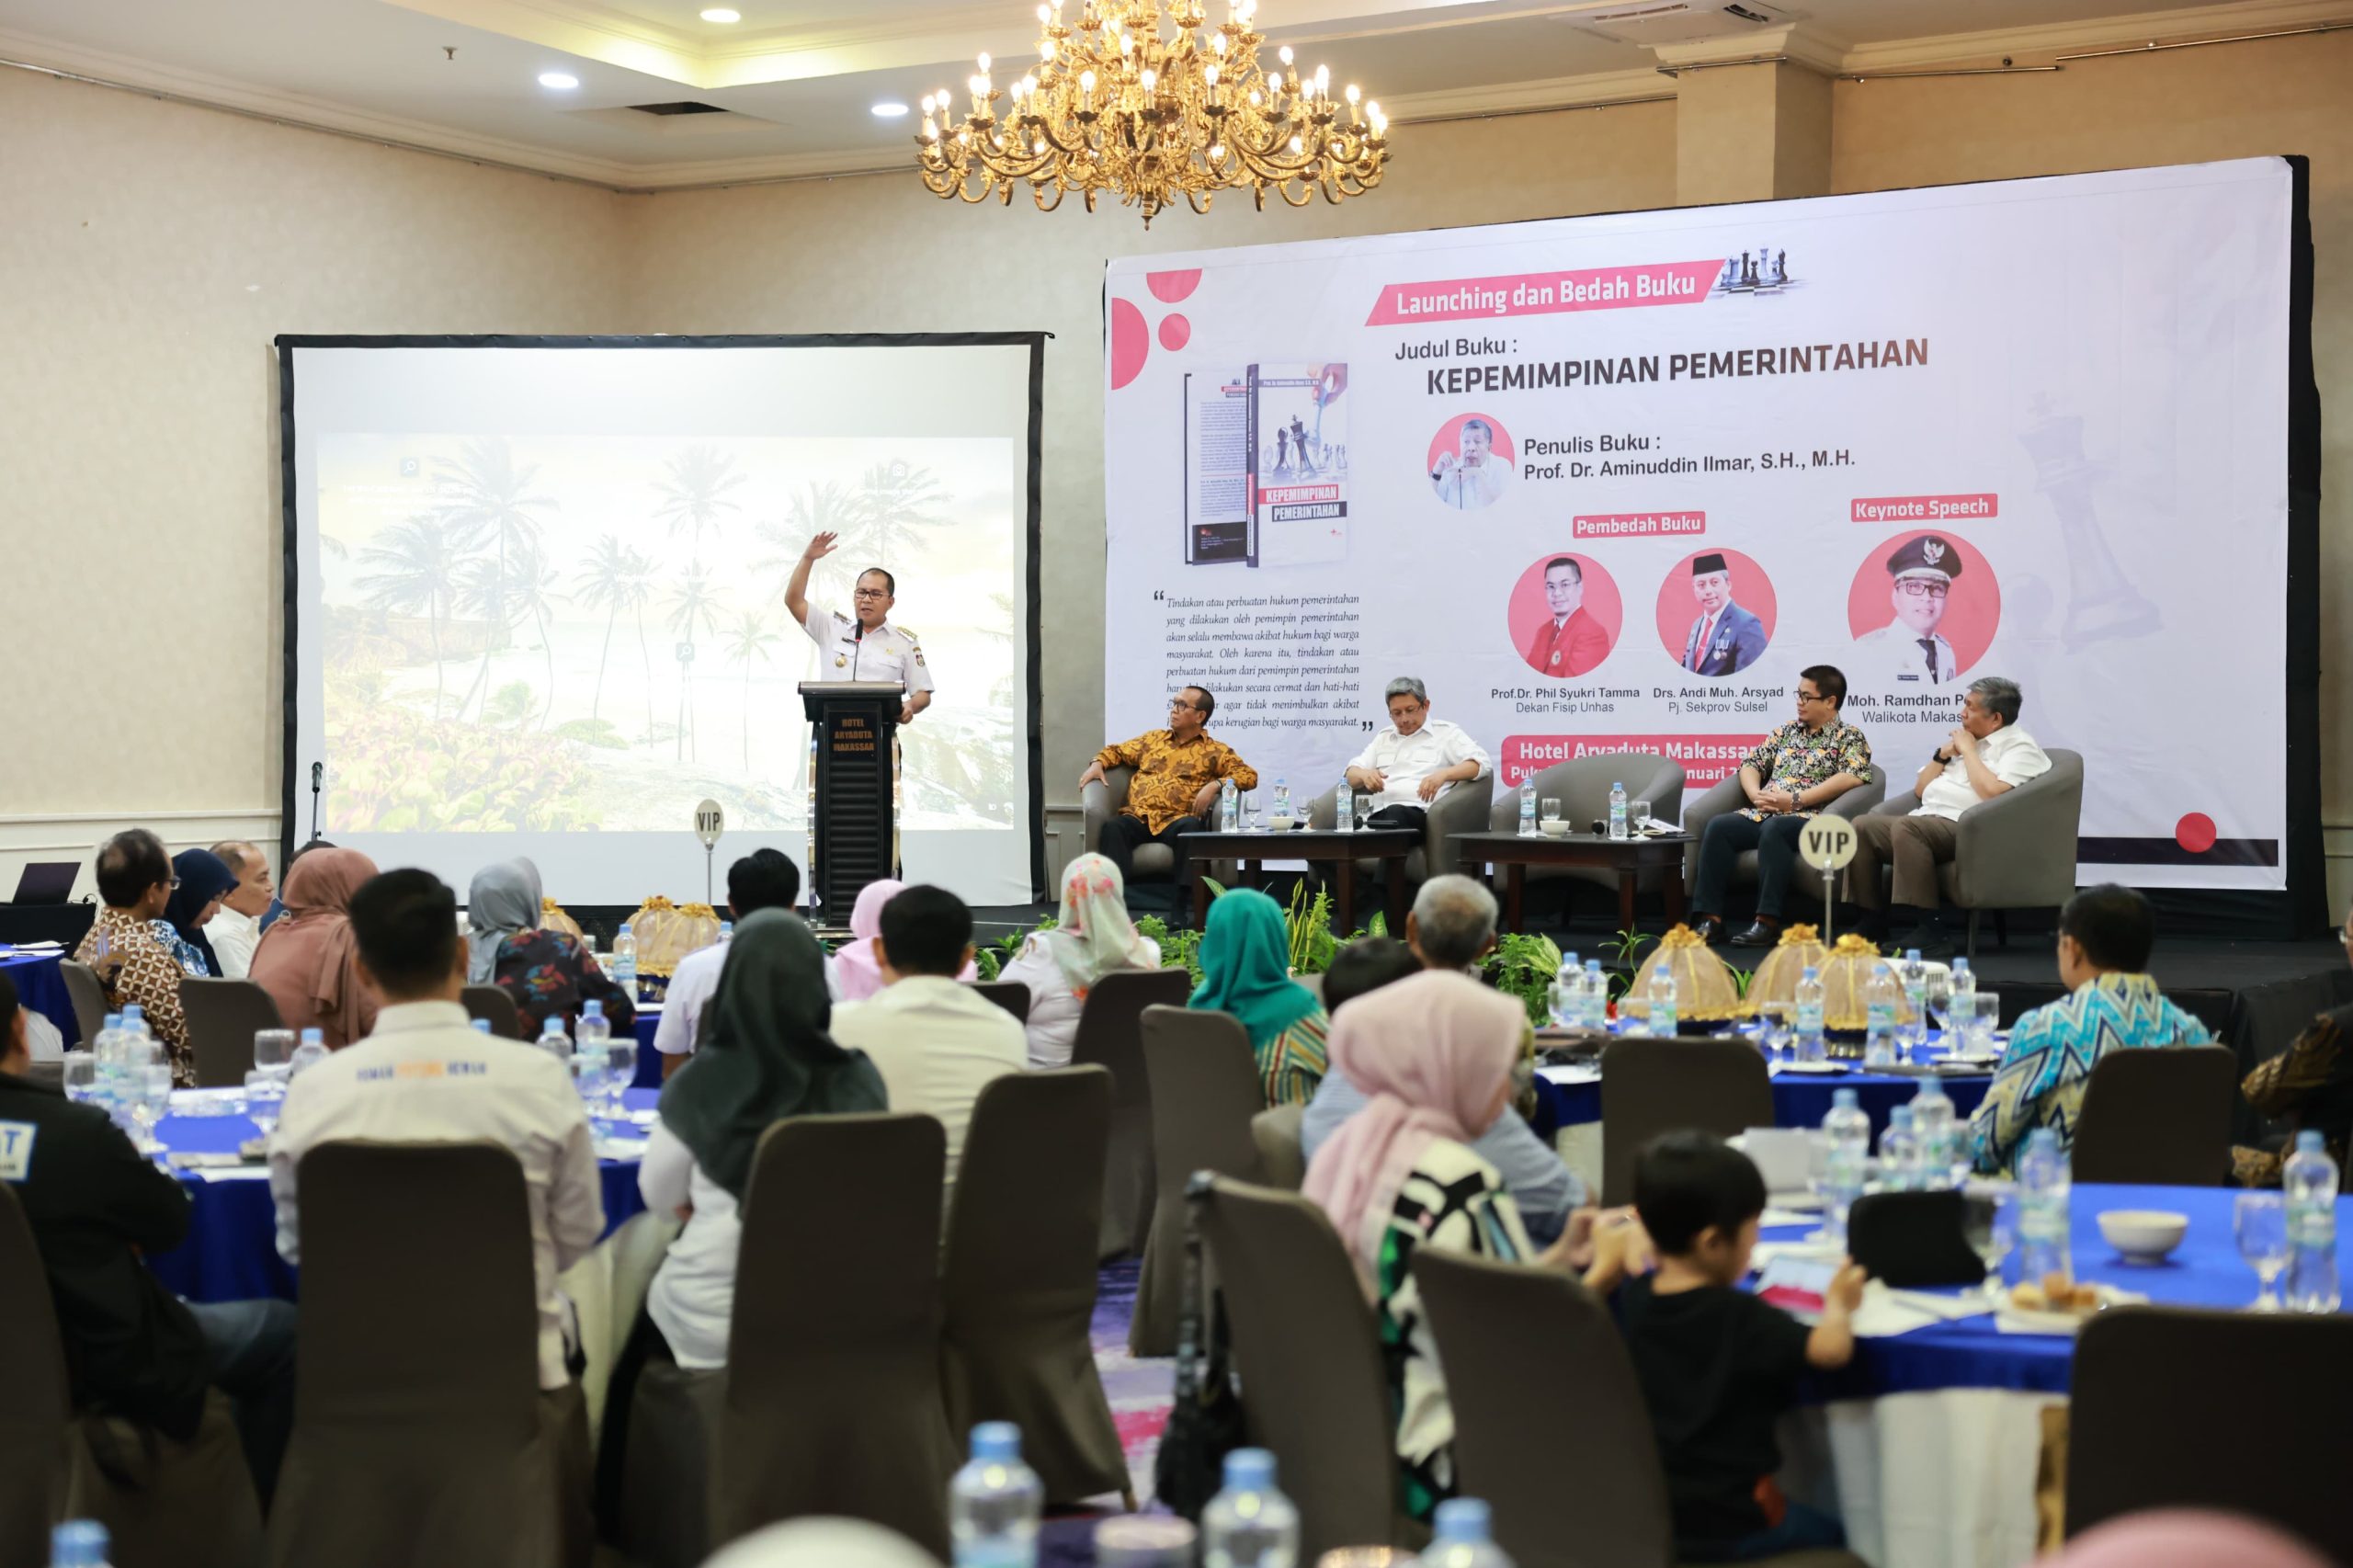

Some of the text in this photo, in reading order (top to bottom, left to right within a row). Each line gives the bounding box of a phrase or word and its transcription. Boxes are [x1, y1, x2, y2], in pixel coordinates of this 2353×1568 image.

[1398, 272, 1695, 314] Launching dan Bedah Buku
[1395, 339, 1449, 360] Judul
[1456, 336, 1506, 356] Buku
[1428, 338, 1927, 394] KEPEMIMPINAN PEMERINTAHAN
[1525, 437, 1593, 456] Penulis
[1600, 434, 1649, 451] Buku
[1525, 449, 1855, 480] Prof. Dr. Aminuddin Ilmar, S.H., M.H.
[1267, 488, 1337, 503] KEPEMIMPINAN
[1274, 504, 1339, 520] PEMERINTAHAN
[1856, 499, 1989, 521] Keynote Speech
[1576, 516, 1701, 536] Pembedah Buku
[1167, 597, 1204, 608] Tindakan
[1226, 596, 1267, 609] perbuatan
[1270, 596, 1299, 606] hukum
[1301, 594, 1358, 608] pemerintahan
[1166, 611, 1358, 628] yang dilakukan oleh pemimpin pemerintahan
[1166, 630, 1359, 642] akan selalu membawa akibat hukum bagi warga
[1167, 647, 1358, 661] masyarakat. Oleh karena itu, tindakan atau
[1166, 665, 1358, 678] perbuatan hukum dari pemimpin pemerintahan
[1274, 684, 1302, 692] cermat
[1304, 681, 1320, 691] dan
[1324, 681, 1359, 691] hati-hati
[1492, 687, 1640, 700] Prof.Dr. Phil Syukri Tamma
[1654, 687, 1784, 700] Drs. Andi Muh. Arsyad
[1224, 702, 1242, 711] agar
[1247, 699, 1267, 710] tidak
[1272, 699, 1328, 709] menimbulkan
[1333, 699, 1359, 709] akibat
[1847, 694, 1879, 707] Moh.
[1885, 694, 1949, 706] Ramdhan
[1517, 702, 1614, 714] Dekan Fisip Unhas
[1669, 701, 1768, 715] Pj. Sekprov Sulsel
[842, 718, 864, 727] HOTEL
[1225, 717, 1260, 729] kerugian
[1262, 717, 1279, 729] bagi
[1281, 719, 1306, 729] warga
[1309, 716, 1358, 729] masyarakat.
[1862, 710, 1962, 723] Walikota Makas
[835, 731, 873, 739] ARYADUTA
[833, 743, 874, 752] MAKASSAR
[1520, 742, 1569, 759] Hotel
[1687, 767, 1725, 779] nuari
[698, 812, 721, 832] VIP
[1808, 832, 1849, 854] VIP
